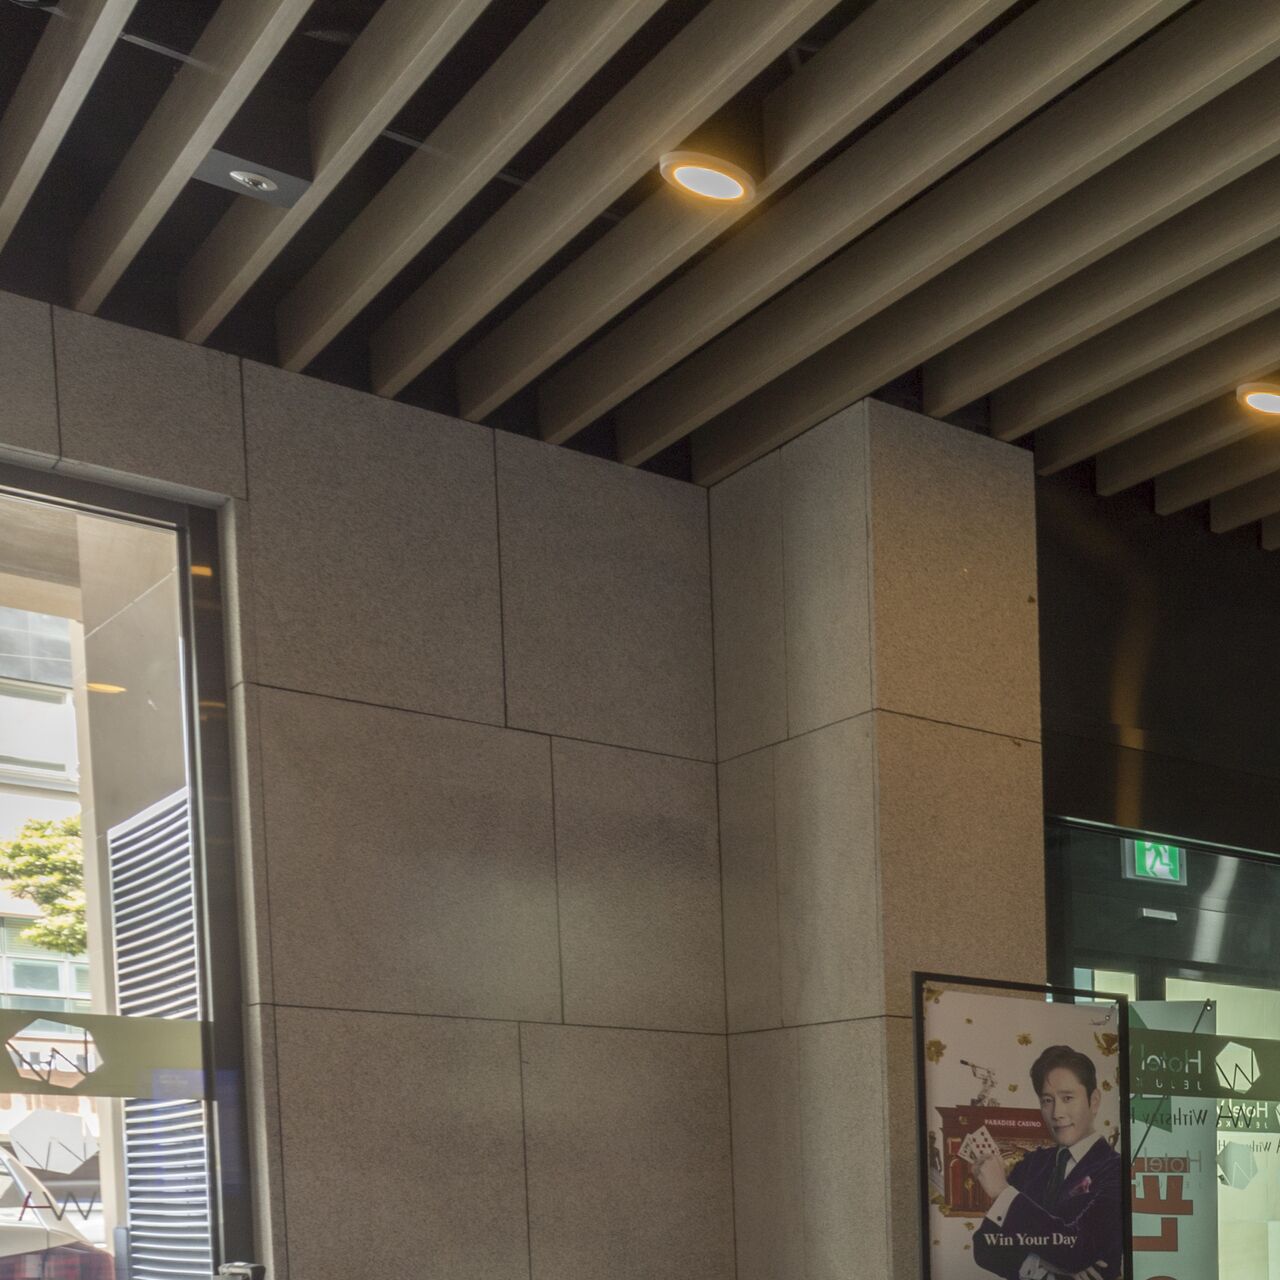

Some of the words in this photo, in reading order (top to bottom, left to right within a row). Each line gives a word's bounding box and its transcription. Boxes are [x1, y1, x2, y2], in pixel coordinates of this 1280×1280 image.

[984, 1119, 1015, 1127] PARADISE
[1018, 1120, 1041, 1128] CASINO
[984, 1233, 1013, 1245] Win
[1017, 1233, 1049, 1245] Your
[1053, 1233, 1077, 1247] Day
